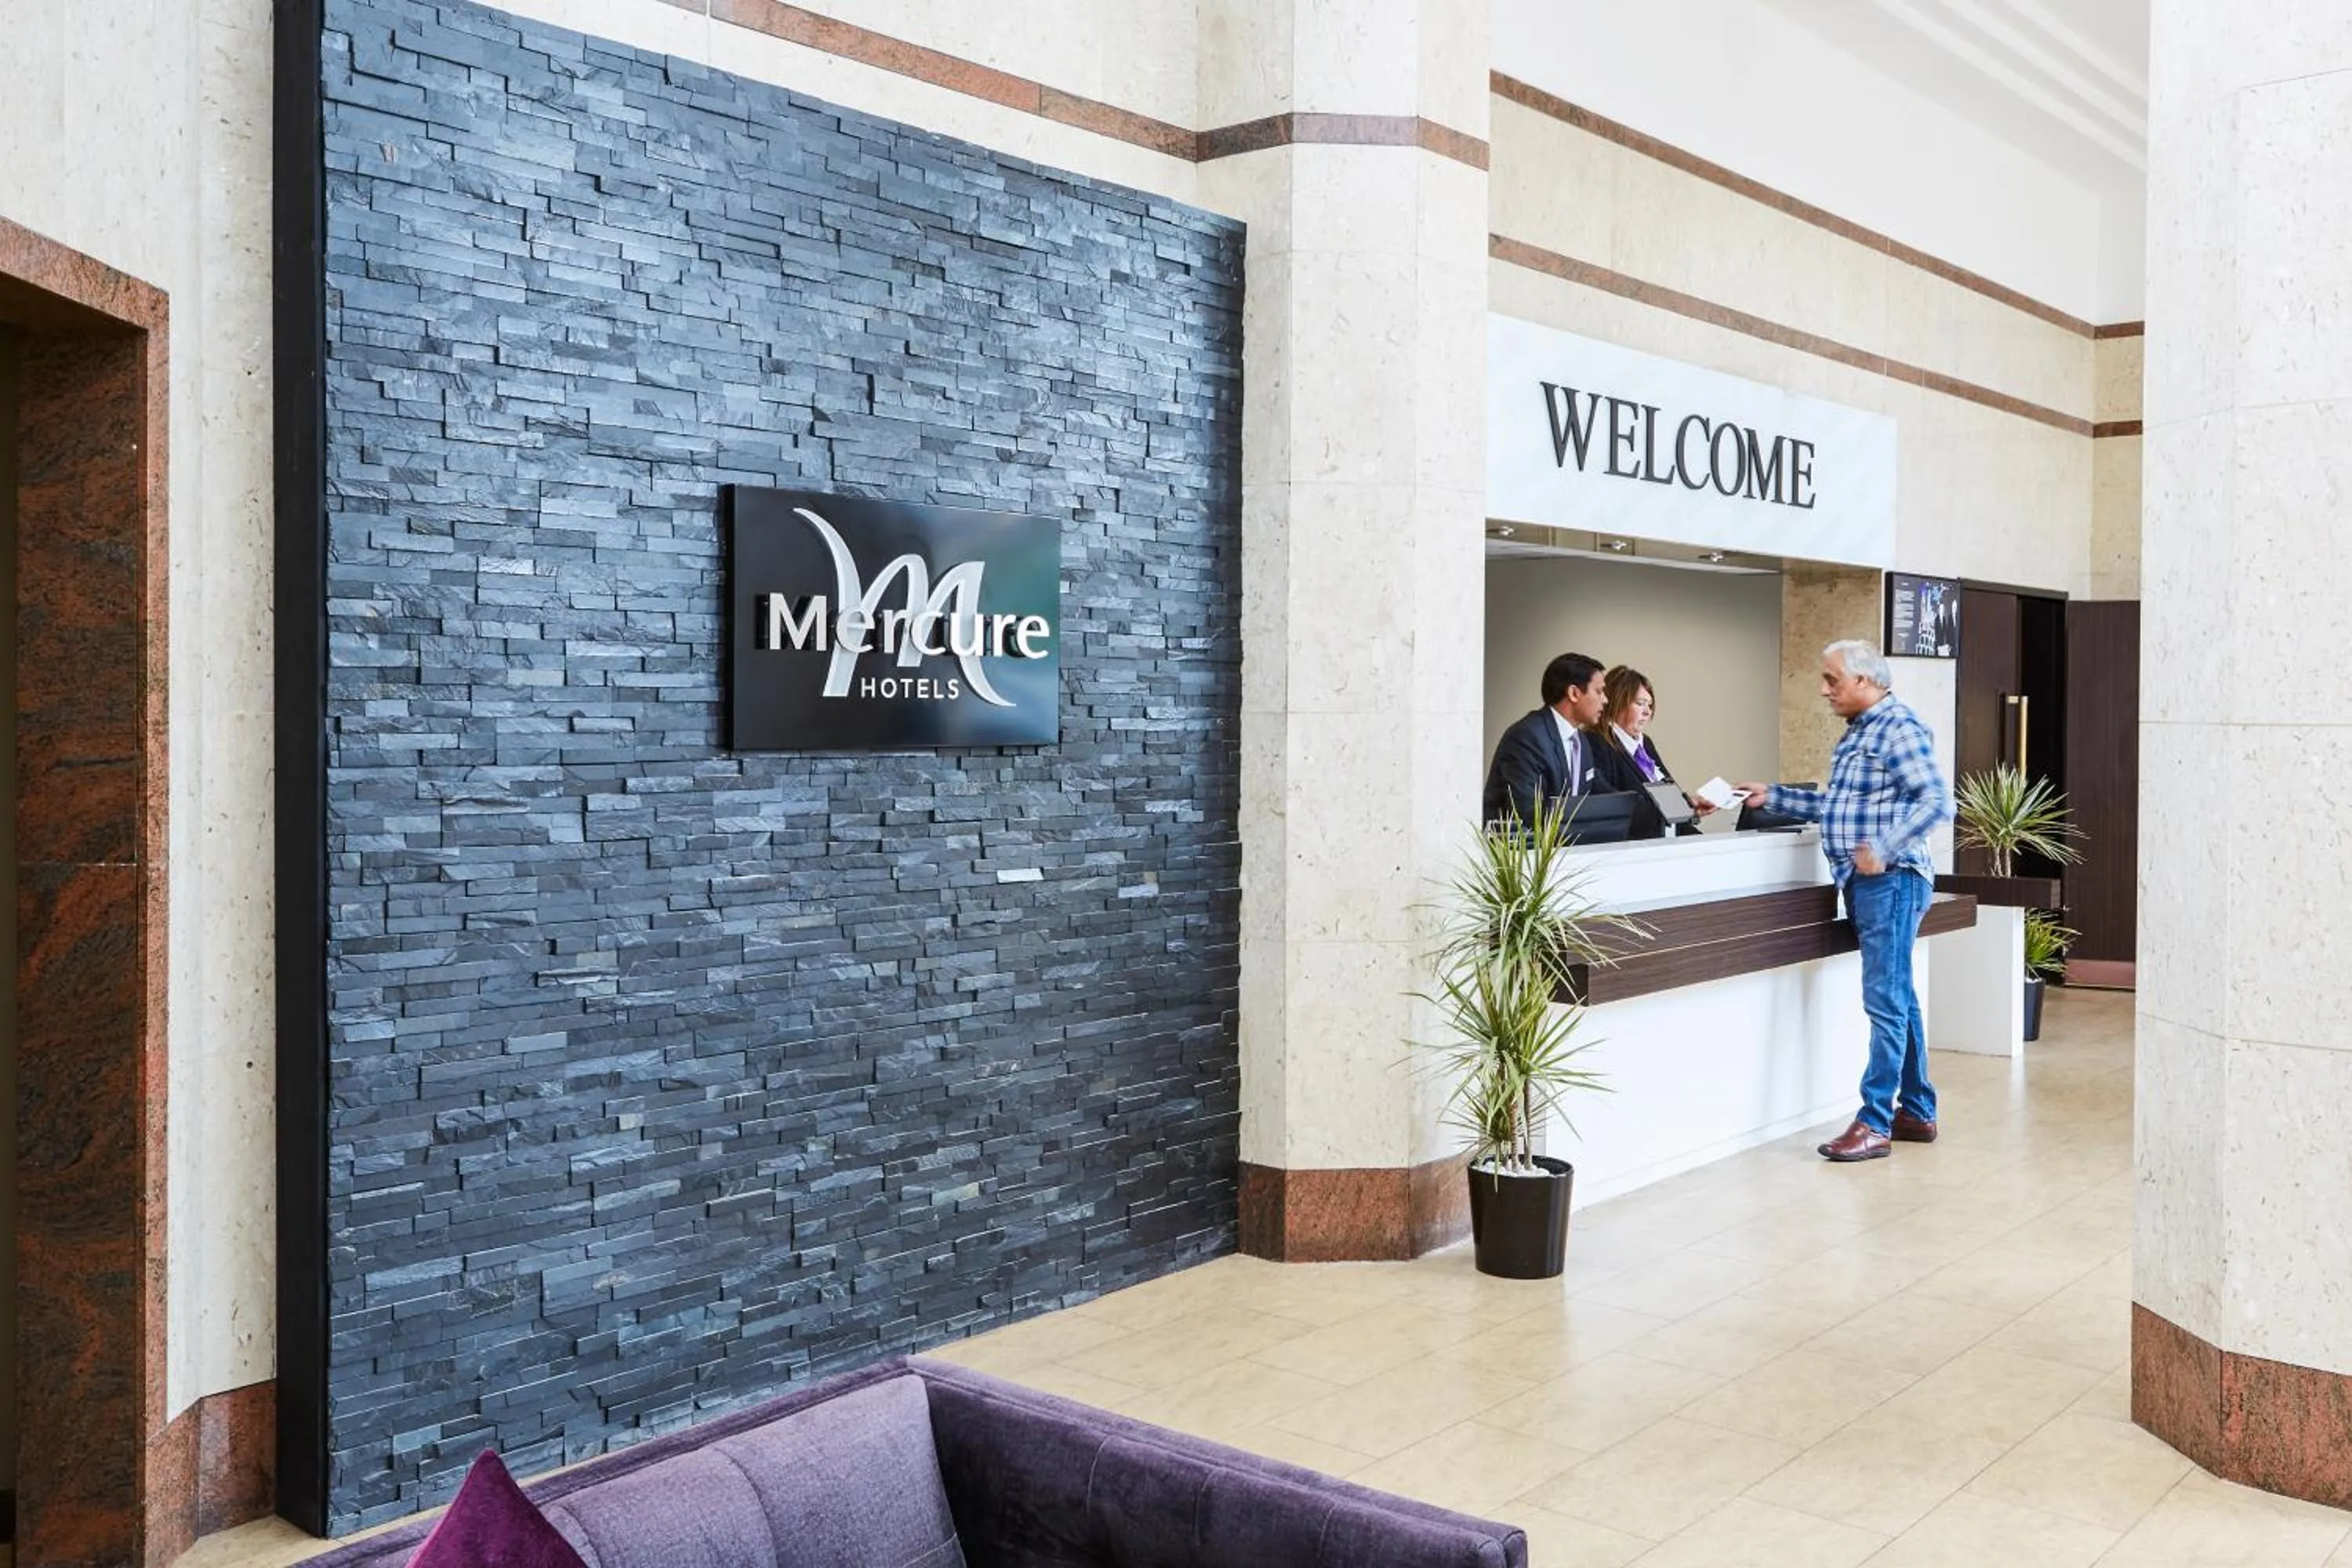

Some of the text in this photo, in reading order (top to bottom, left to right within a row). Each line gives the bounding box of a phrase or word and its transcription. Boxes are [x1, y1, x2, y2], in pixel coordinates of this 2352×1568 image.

[1540, 382, 1816, 509] WELCOME
[768, 593, 1050, 659] Mercure
[862, 677, 960, 699] HOTELS
